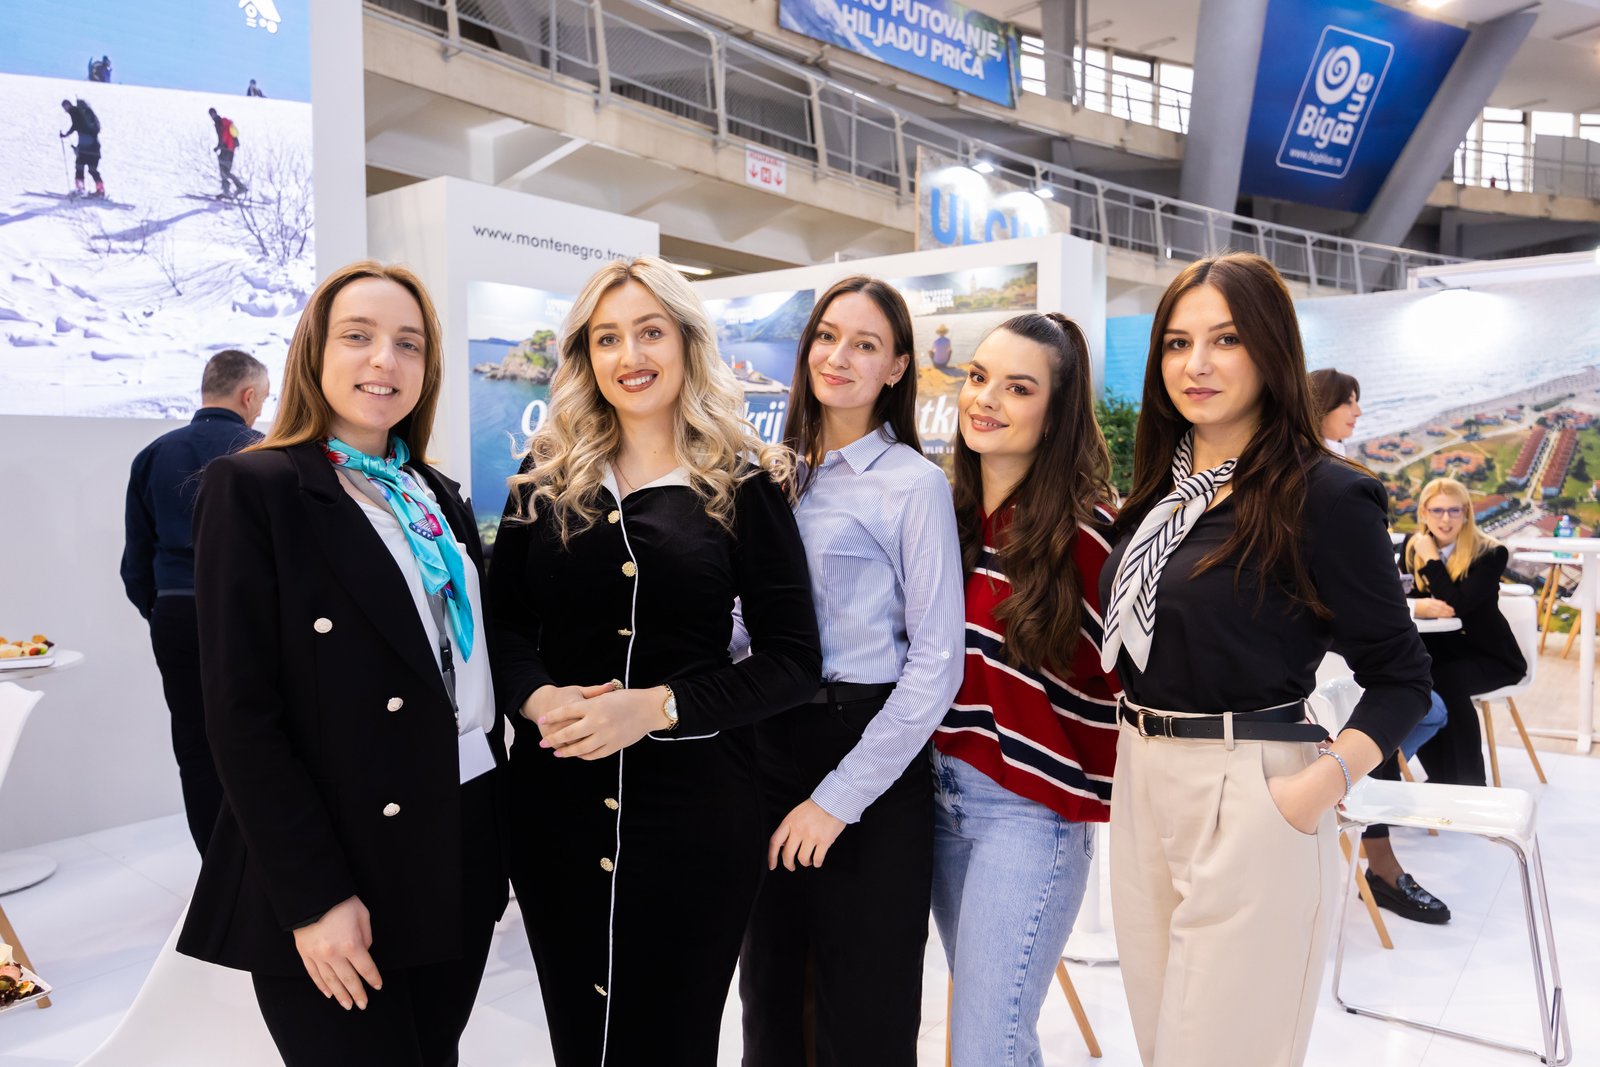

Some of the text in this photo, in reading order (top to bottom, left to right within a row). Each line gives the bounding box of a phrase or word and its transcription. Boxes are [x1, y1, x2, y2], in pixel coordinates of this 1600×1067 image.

[842, 4, 985, 80] HILJADU PRIČA
[891, 0, 1002, 62] PUTOVANJE,
[1296, 104, 1336, 149] Big
[1330, 72, 1375, 146] Blue
[931, 186, 1046, 245] ULC
[743, 401, 786, 444] krij
